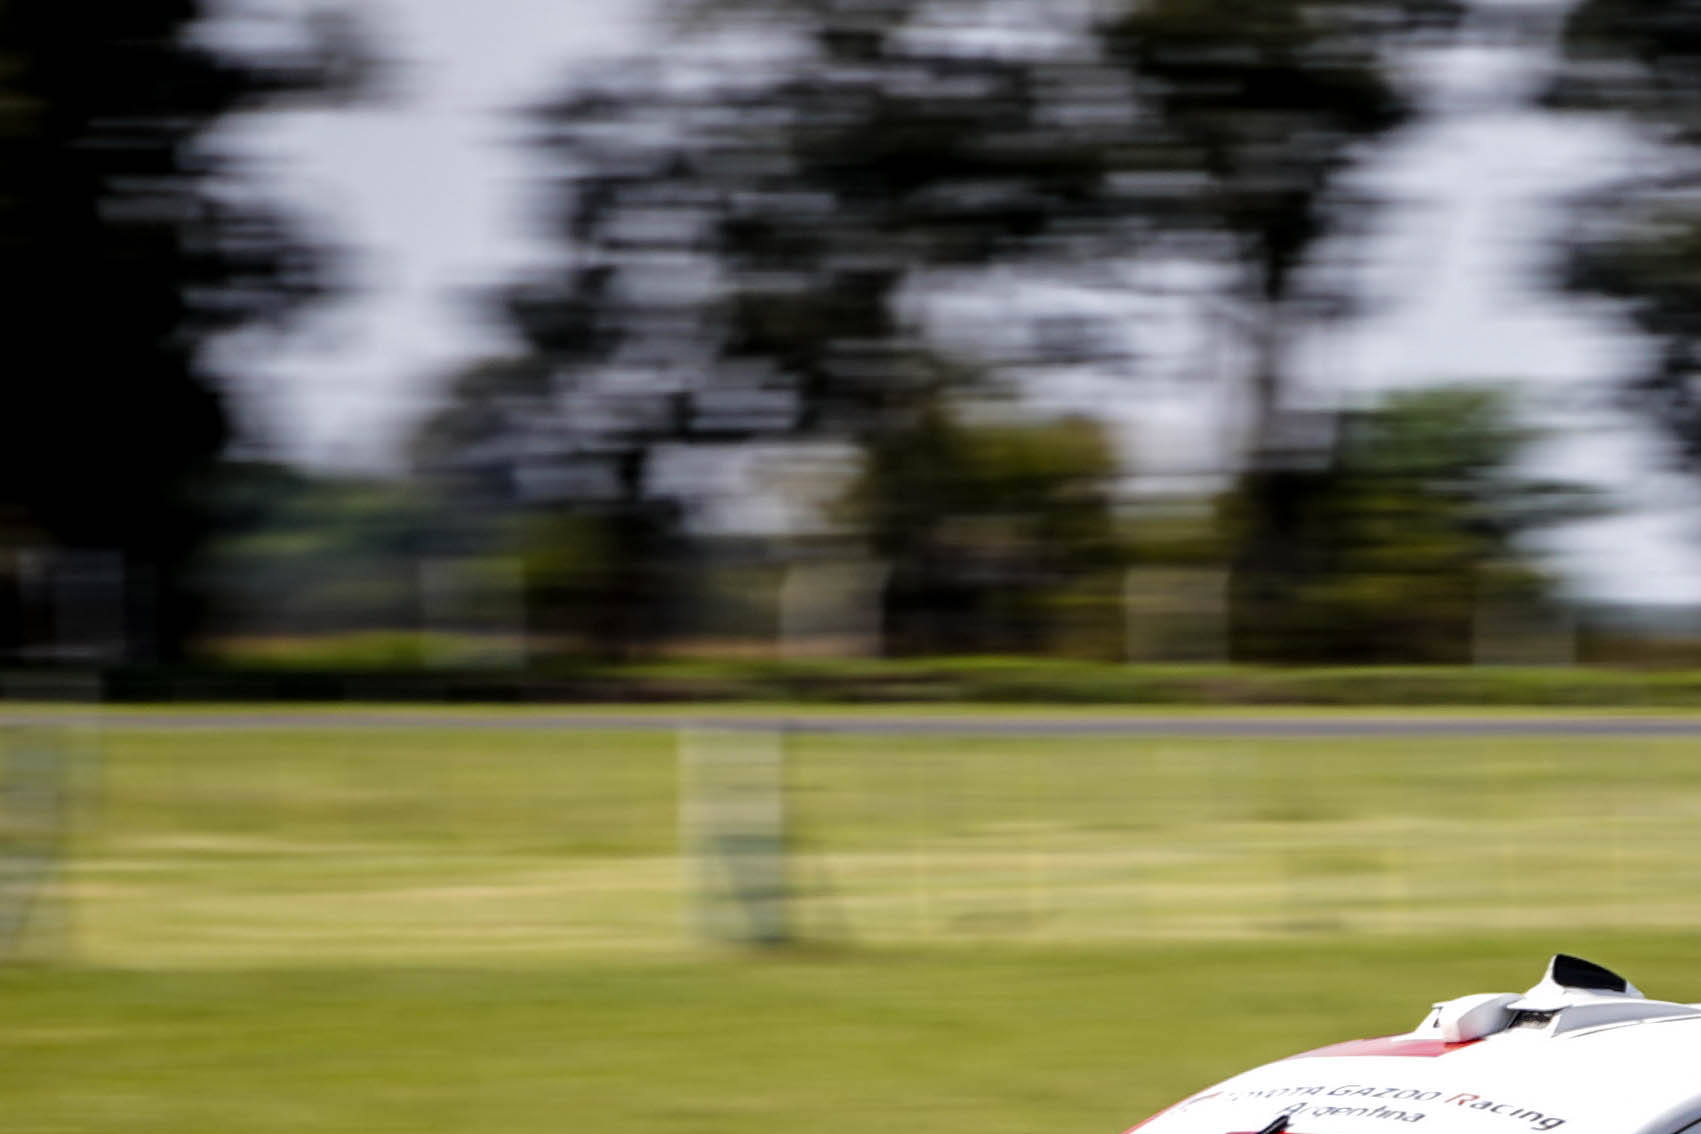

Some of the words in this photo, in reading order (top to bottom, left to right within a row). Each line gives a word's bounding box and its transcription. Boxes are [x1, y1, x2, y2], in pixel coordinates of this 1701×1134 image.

[1278, 1101, 1427, 1125] Argentina
[1332, 1083, 1443, 1104] GAZOO
[1446, 1092, 1568, 1132] Racing
